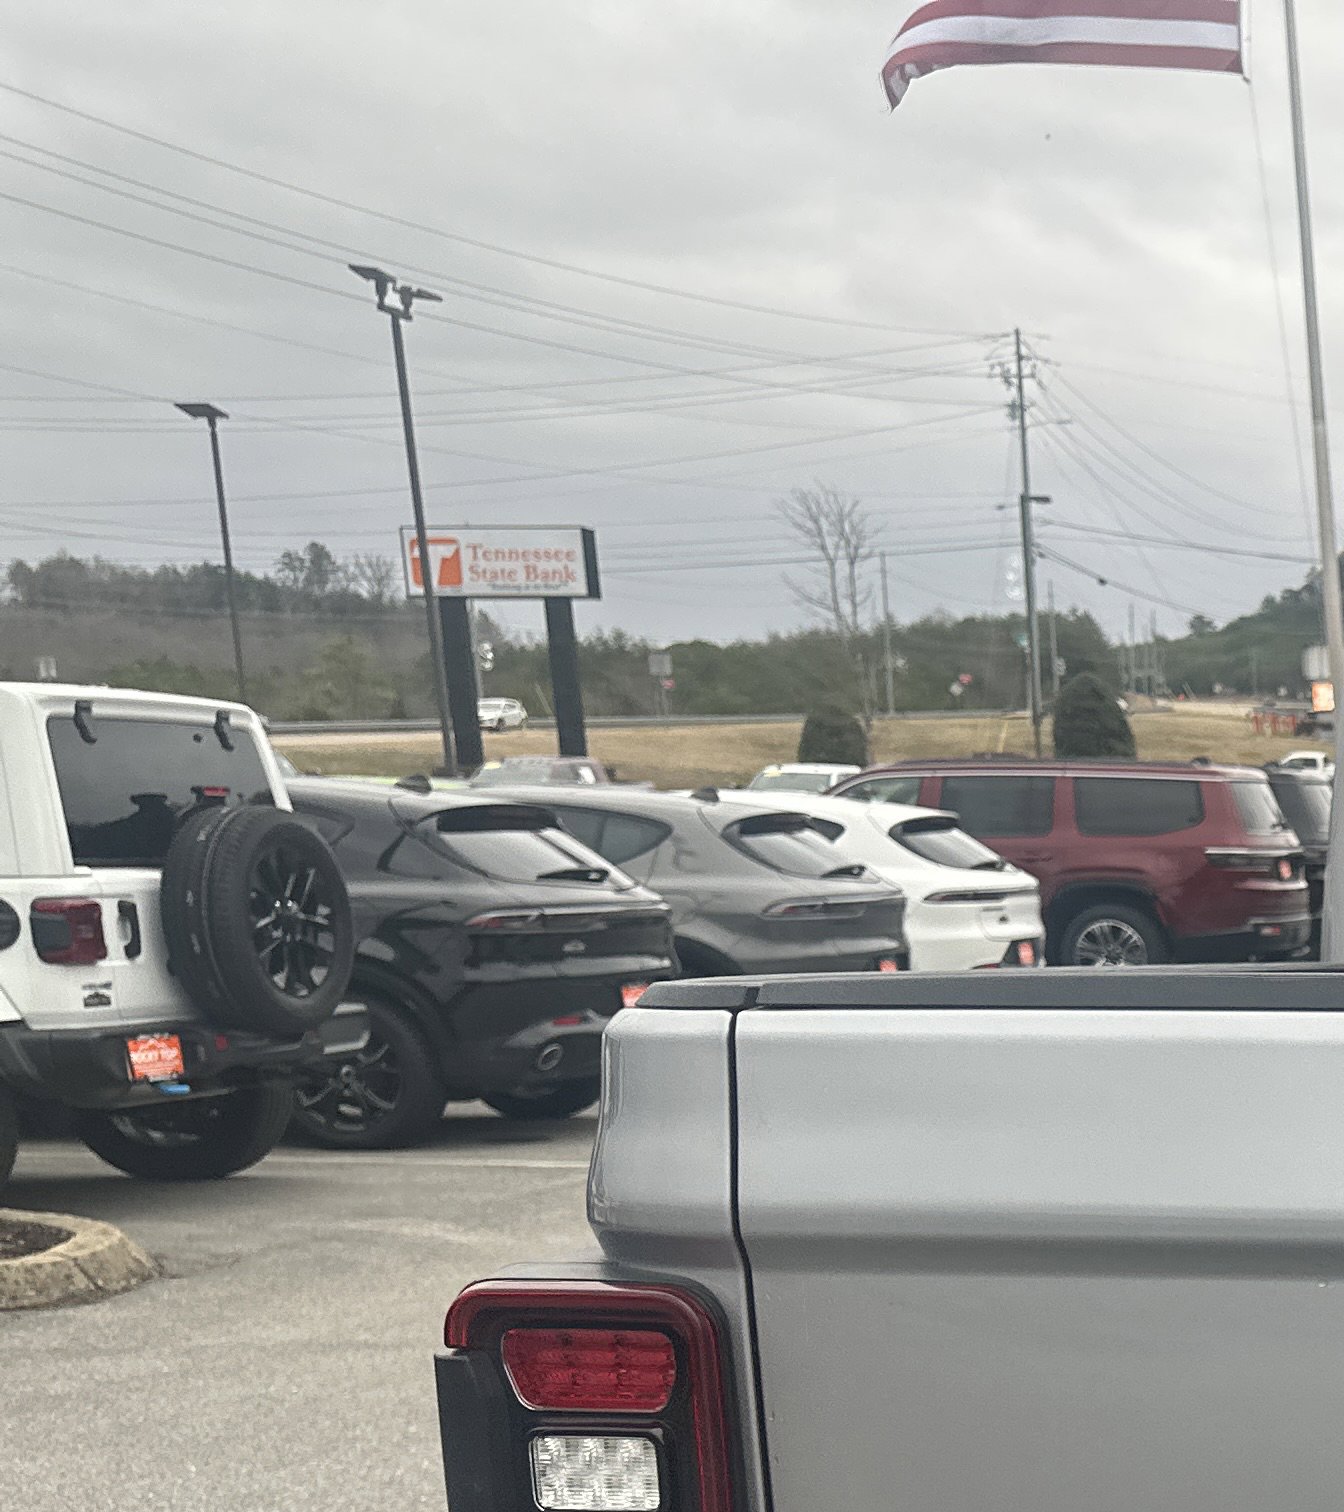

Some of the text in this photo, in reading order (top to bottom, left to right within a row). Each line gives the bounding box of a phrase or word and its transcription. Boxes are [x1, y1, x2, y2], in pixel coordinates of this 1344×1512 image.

[466, 543, 577, 562] Tennessee
[468, 563, 577, 583] State Bank
